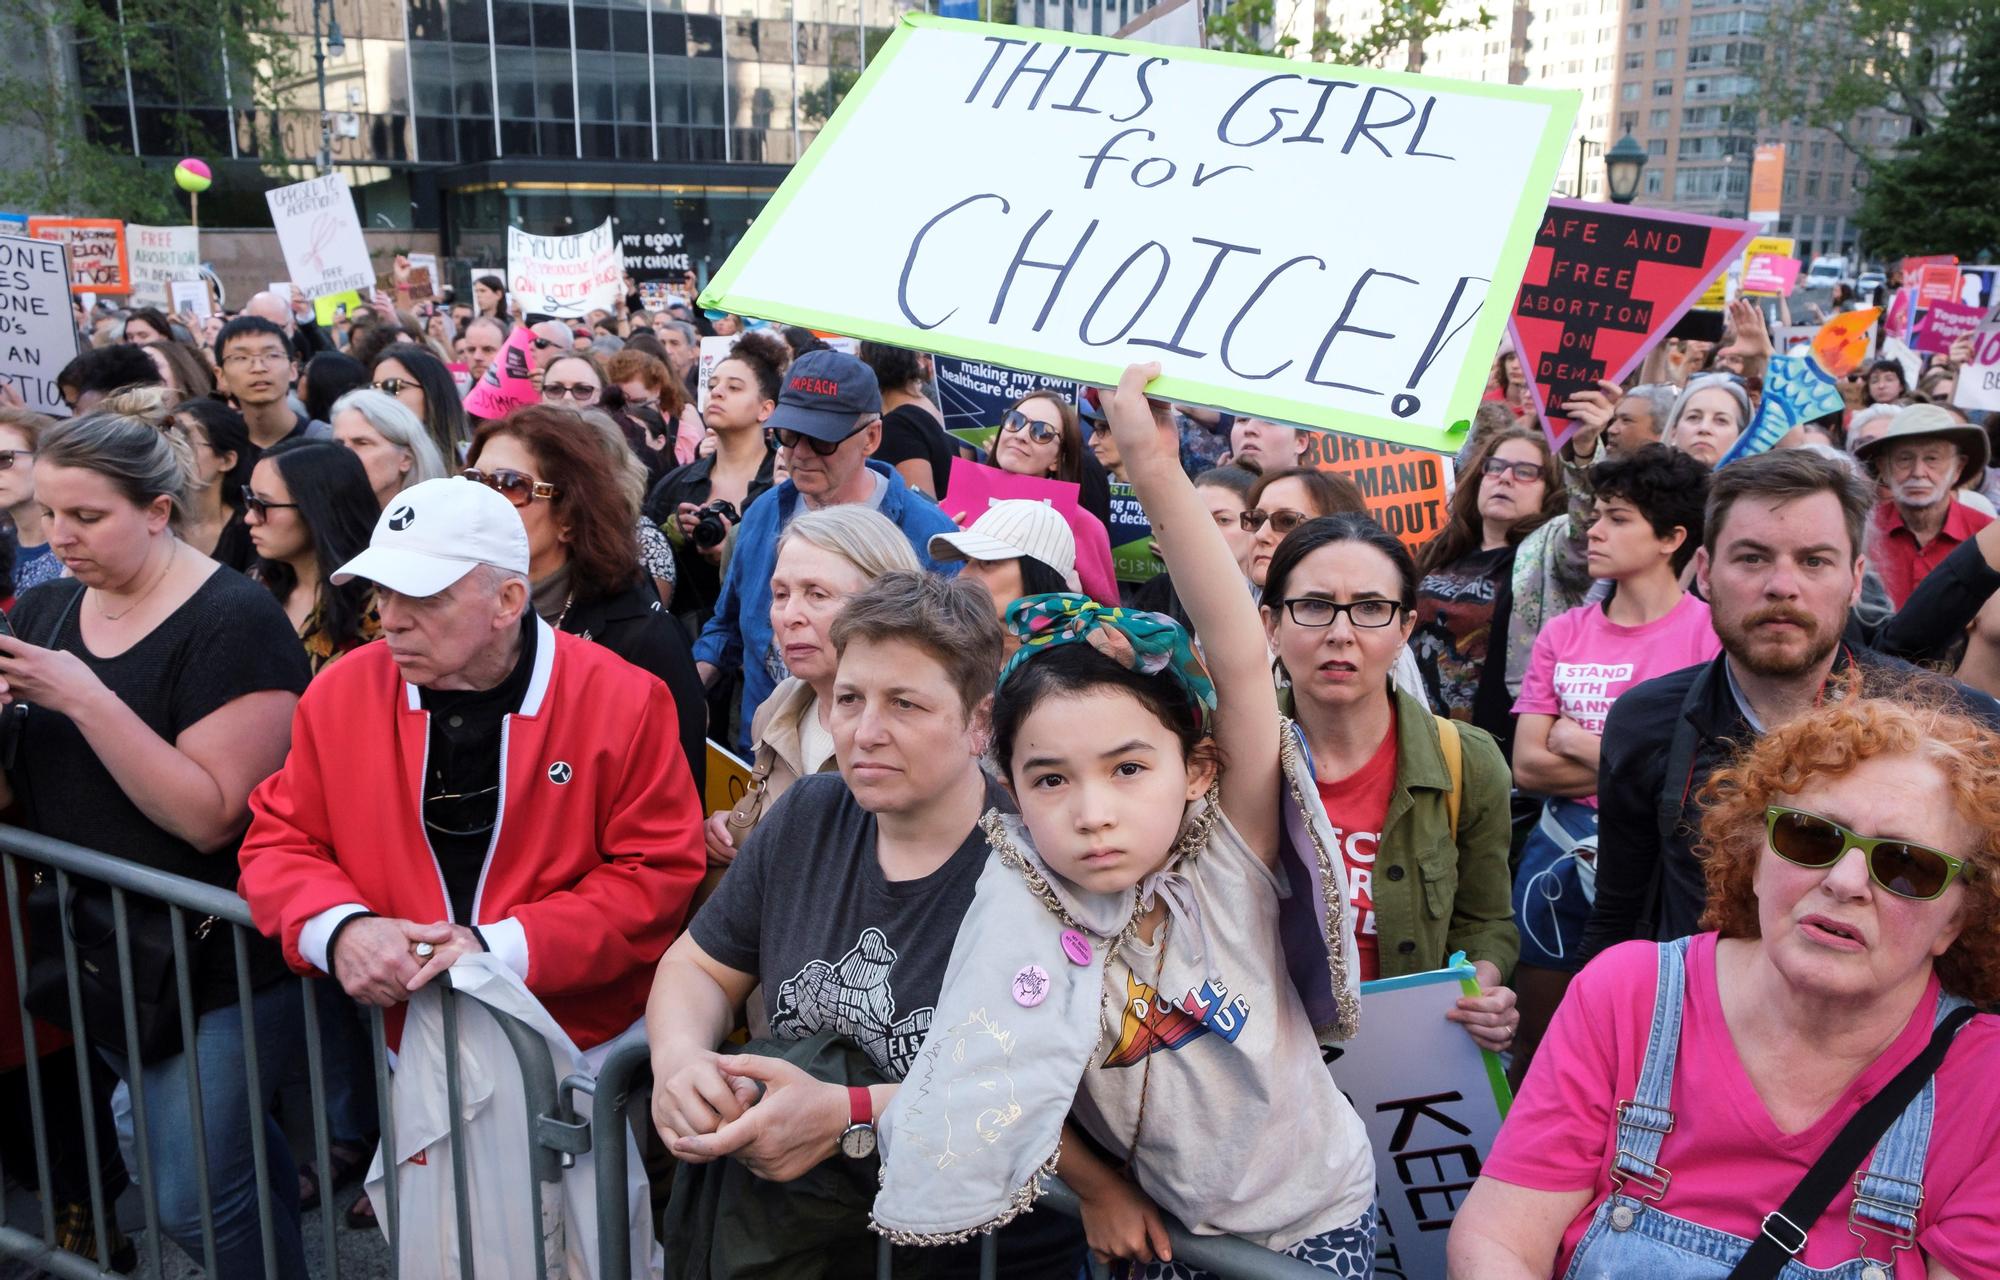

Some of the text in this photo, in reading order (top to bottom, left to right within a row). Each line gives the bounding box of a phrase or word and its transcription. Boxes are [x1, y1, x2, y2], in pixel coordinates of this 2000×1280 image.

[965, 38, 1456, 161] THIS GIRL
[1078, 128, 1254, 190] for
[141, 231, 172, 248] FREE
[559, 234, 584, 259] CUT
[622, 233, 684, 248] MY BODY
[1542, 218, 1681, 253] AFE AND
[623, 256, 642, 269] MY
[644, 254, 689, 271] CHOICE
[1554, 261, 1631, 290] FREE
[897, 193, 1490, 418] CHOICE!
[1522, 294, 1650, 325] ABORTION
[1563, 332, 1594, 350] ON
[8, 346, 40, 366] AN
[788, 376, 838, 396] IMPEACH
[941, 365, 1002, 397] healthcare
[961, 361, 1009, 386] making
[1012, 372, 1037, 389] my
[1344, 459, 1438, 498] MAND
[1566, 667, 1628, 682] STAND
